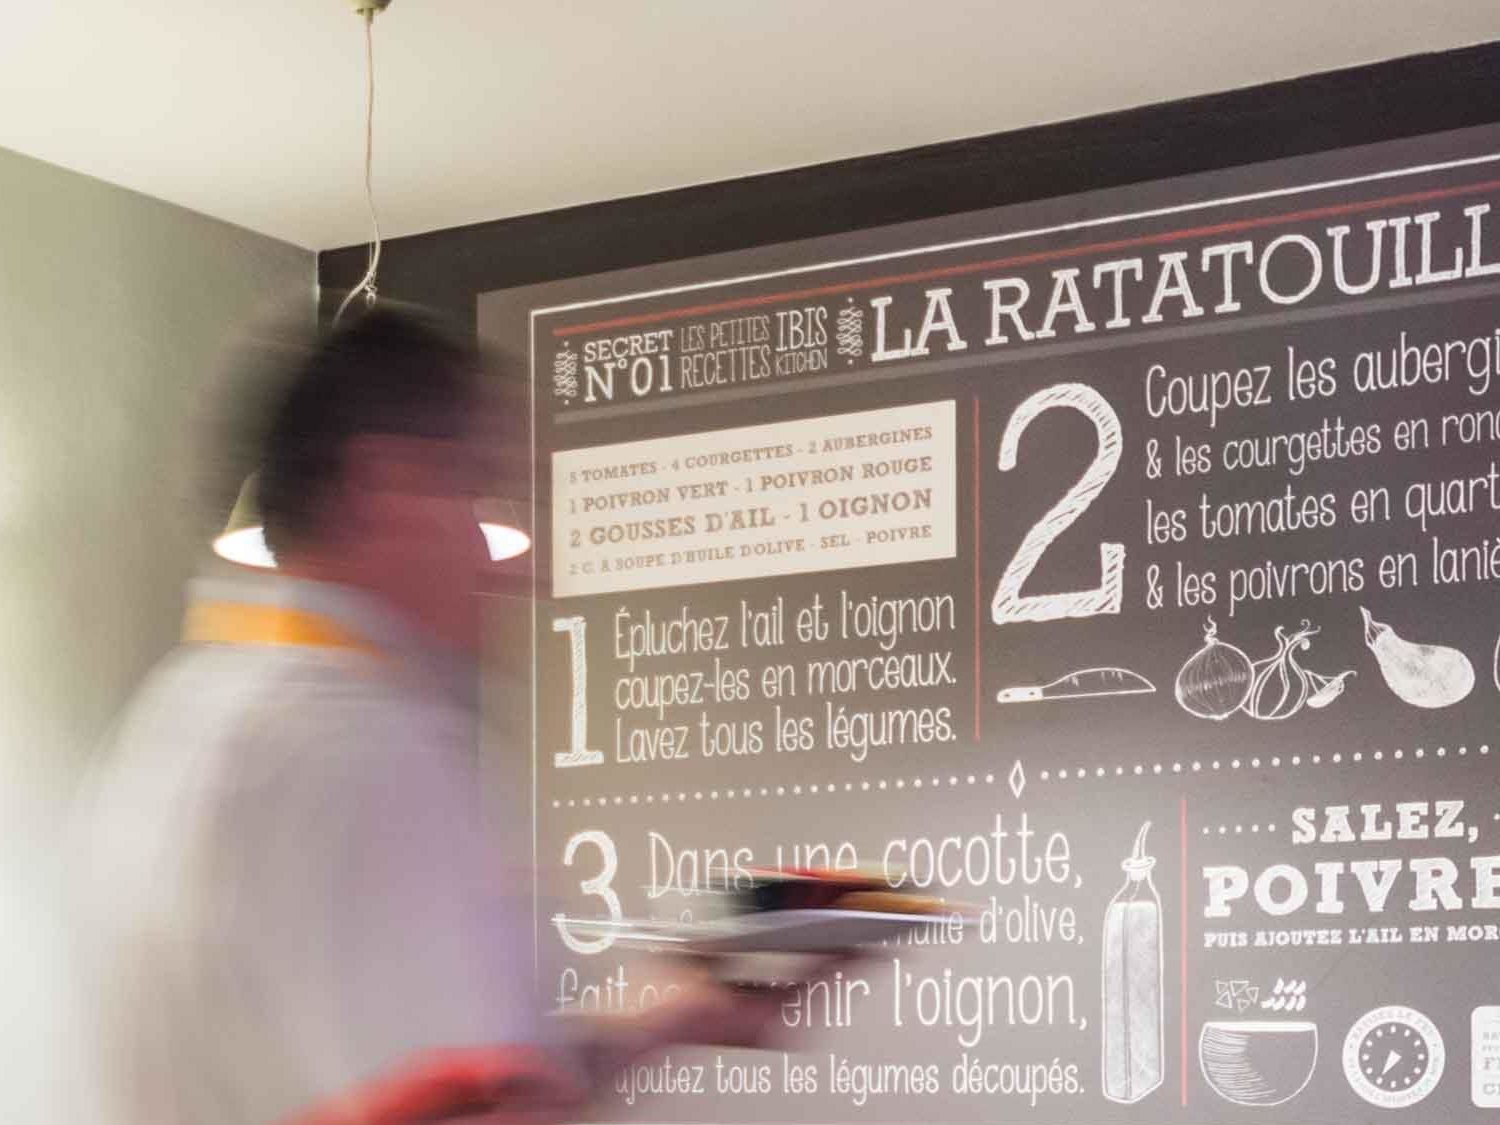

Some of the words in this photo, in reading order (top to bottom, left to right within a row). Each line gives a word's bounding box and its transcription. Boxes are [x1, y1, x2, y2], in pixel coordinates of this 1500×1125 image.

[870, 288, 967, 362] LA
[984, 204, 1500, 345] RATATOUILL
[584, 329, 673, 362] SECRET
[681, 326, 705, 353] LES
[710, 315, 770, 348] PETITES
[776, 306, 828, 351] IBIS
[681, 344, 771, 389] RECETTES
[775, 350, 828, 376] KITCHEN
[1146, 365, 1271, 427] Coupez
[1286, 346, 1337, 400] les
[581, 461, 657, 482] TOMATES
[685, 444, 793, 469] COURGETTES
[822, 426, 932, 452] AUBERGINES
[1146, 439, 1162, 479] &
[1175, 436, 1211, 475] les
[1223, 416, 1381, 475] courgettes
[1395, 418, 1428, 452] en
[583, 488, 670, 512] POIVRON
[676, 480, 728, 501] VERT
[760, 465, 854, 491] POIVRON
[862, 456, 932, 479] ROUGE
[992, 383, 1126, 624] 2
[570, 530, 581, 548] 2
[590, 516, 695, 545] GOUSSES
[705, 507, 775, 533] D'AIL
[800, 503, 809, 522] 1
[818, 488, 932, 520] OIGNON
[820, 533, 850, 549] SEL
[866, 525, 932, 544] POIVRE
[1147, 499, 1186, 544] les
[1200, 485, 1336, 538] tomates
[1351, 487, 1390, 523] en
[1146, 565, 1163, 609] &
[1176, 561, 1217, 602] les
[1229, 556, 1364, 618] poivrons
[1379, 554, 1418, 589] en
[615, 606, 729, 671] Épluchez
[740, 597, 784, 648] l'ail
[797, 593, 828, 643] et
[842, 590, 956, 650] l'oignon
[552, 615, 604, 768] 1
[615, 658, 750, 720] coupez-les
[762, 666, 795, 700] en
[808, 651, 957, 696] morceaux.
[616, 717, 689, 764] Lavez
[700, 711, 763, 758] tous
[776, 705, 814, 752] les
[826, 701, 957, 762] légumes.
[1291, 800, 1479, 844] SALEZ,
[647, 831, 753, 898] Dans
[882, 812, 1083, 889] cocotte,
[554, 830, 623, 954] 3
[1202, 855, 1500, 917] POIVRE
[980, 896, 1084, 945] d'olive,
[1203, 931, 1251, 948] PUIS
[1253, 929, 1342, 947] AJOUTEZ
[1349, 927, 1402, 945] L'AIL
[1409, 925, 1440, 943] EN
[1446, 922, 1500, 943] MOR
[893, 958, 1088, 1048] l'oignon,
[716, 1055, 772, 1094] tous
[783, 1054, 818, 1095] les
[829, 1054, 940, 1105] légumes
[951, 1054, 1085, 1106] découpés.
